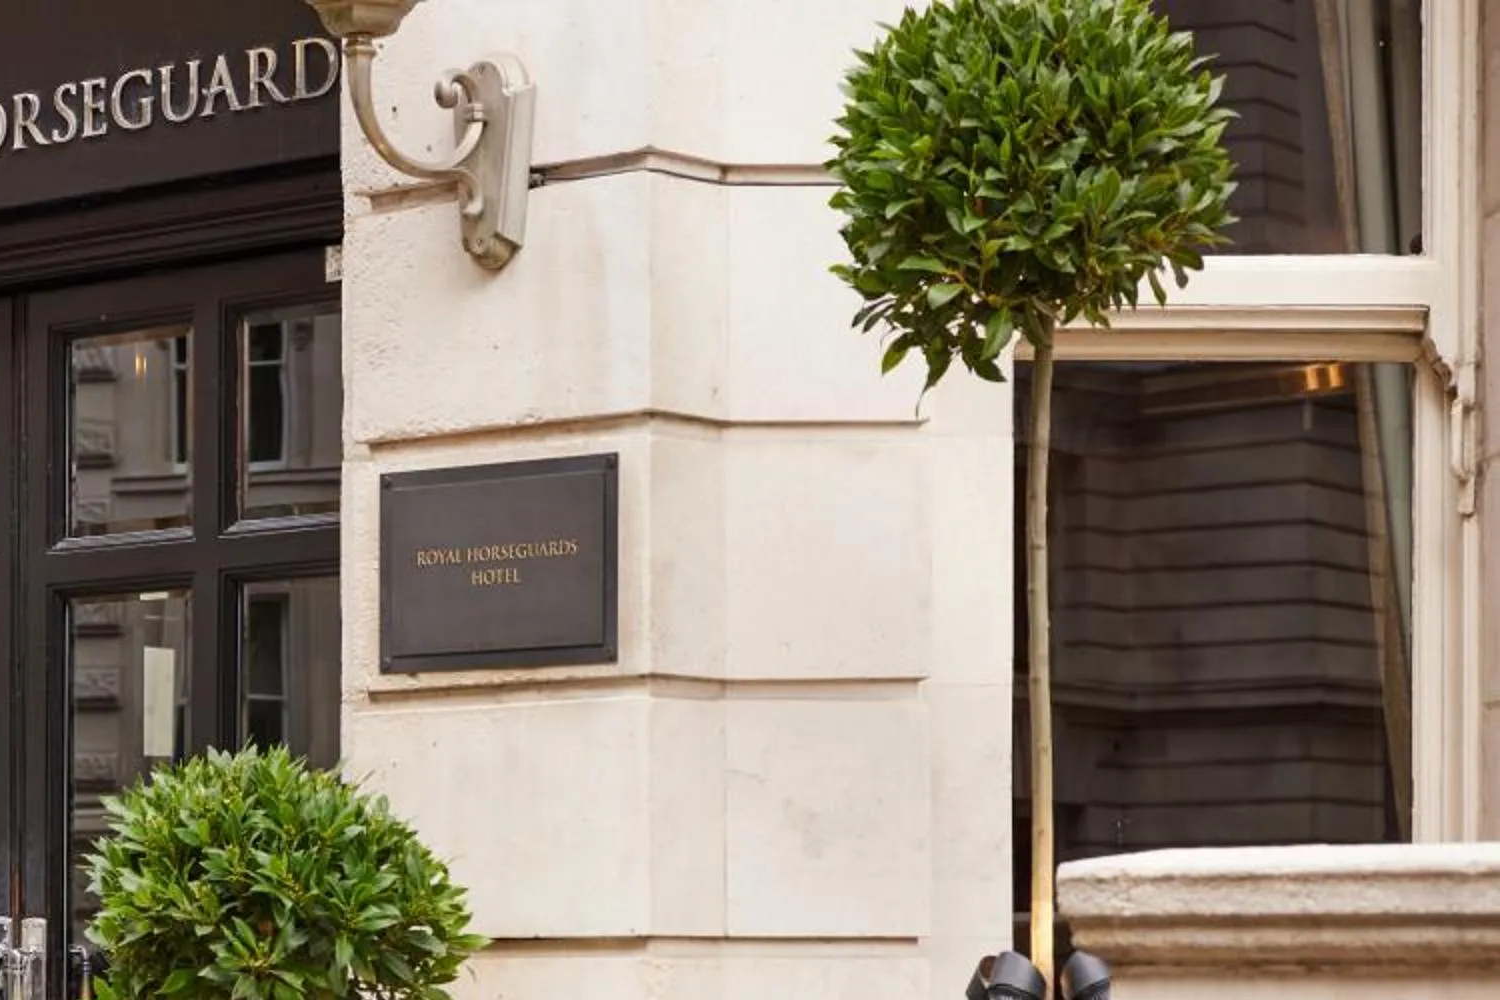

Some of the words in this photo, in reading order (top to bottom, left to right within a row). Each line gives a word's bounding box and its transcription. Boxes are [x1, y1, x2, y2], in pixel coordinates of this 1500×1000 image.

[417, 548, 462, 567] ROYAL
[467, 539, 577, 562] HORSEGUARDS
[471, 568, 520, 585] HOTEL
